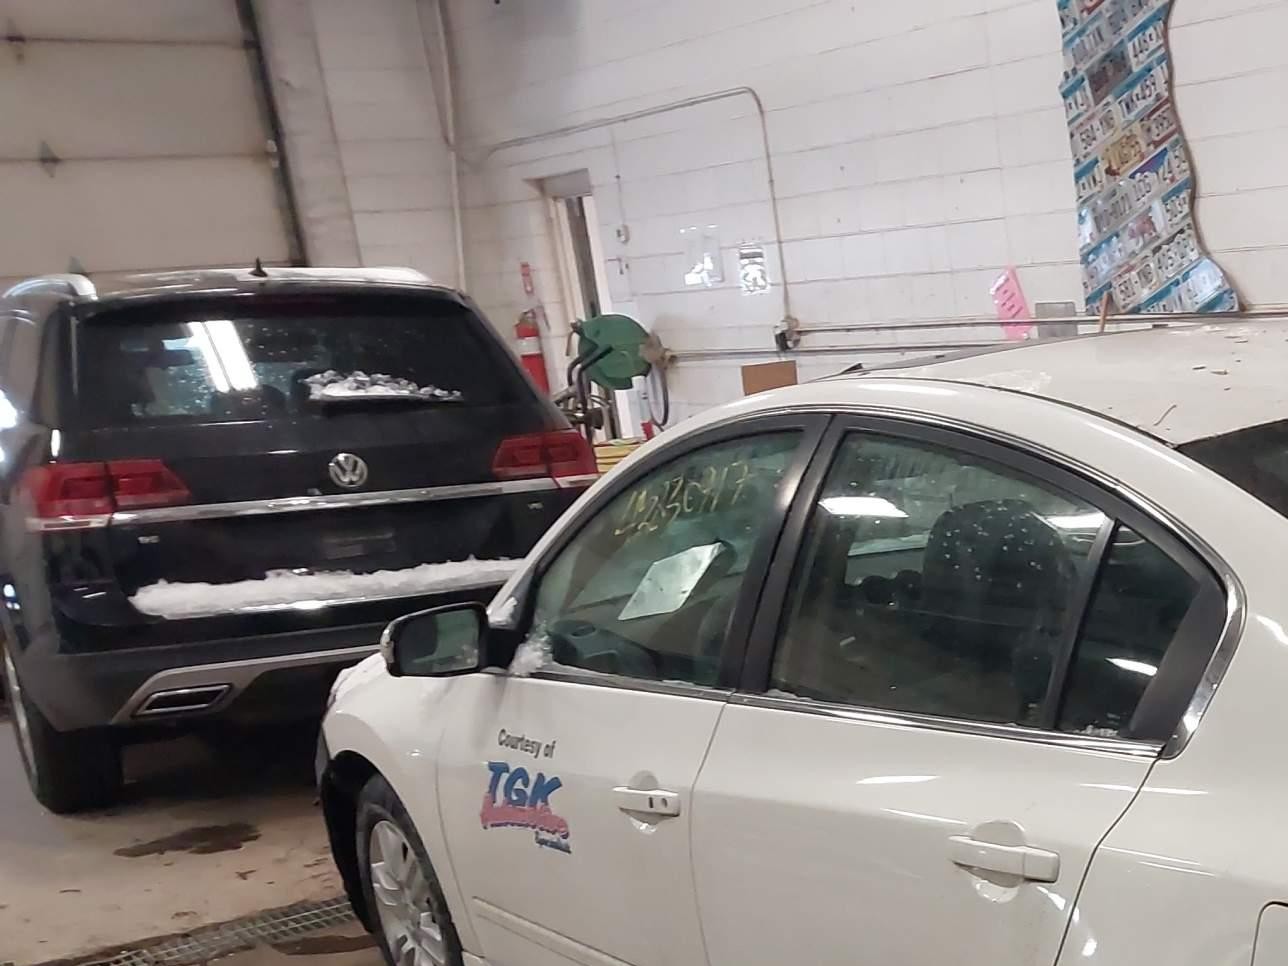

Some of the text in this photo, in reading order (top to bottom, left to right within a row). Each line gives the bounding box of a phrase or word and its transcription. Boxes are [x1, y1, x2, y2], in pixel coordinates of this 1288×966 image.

[498, 728, 557, 759] Courtesy of
[487, 761, 563, 808] TGK
